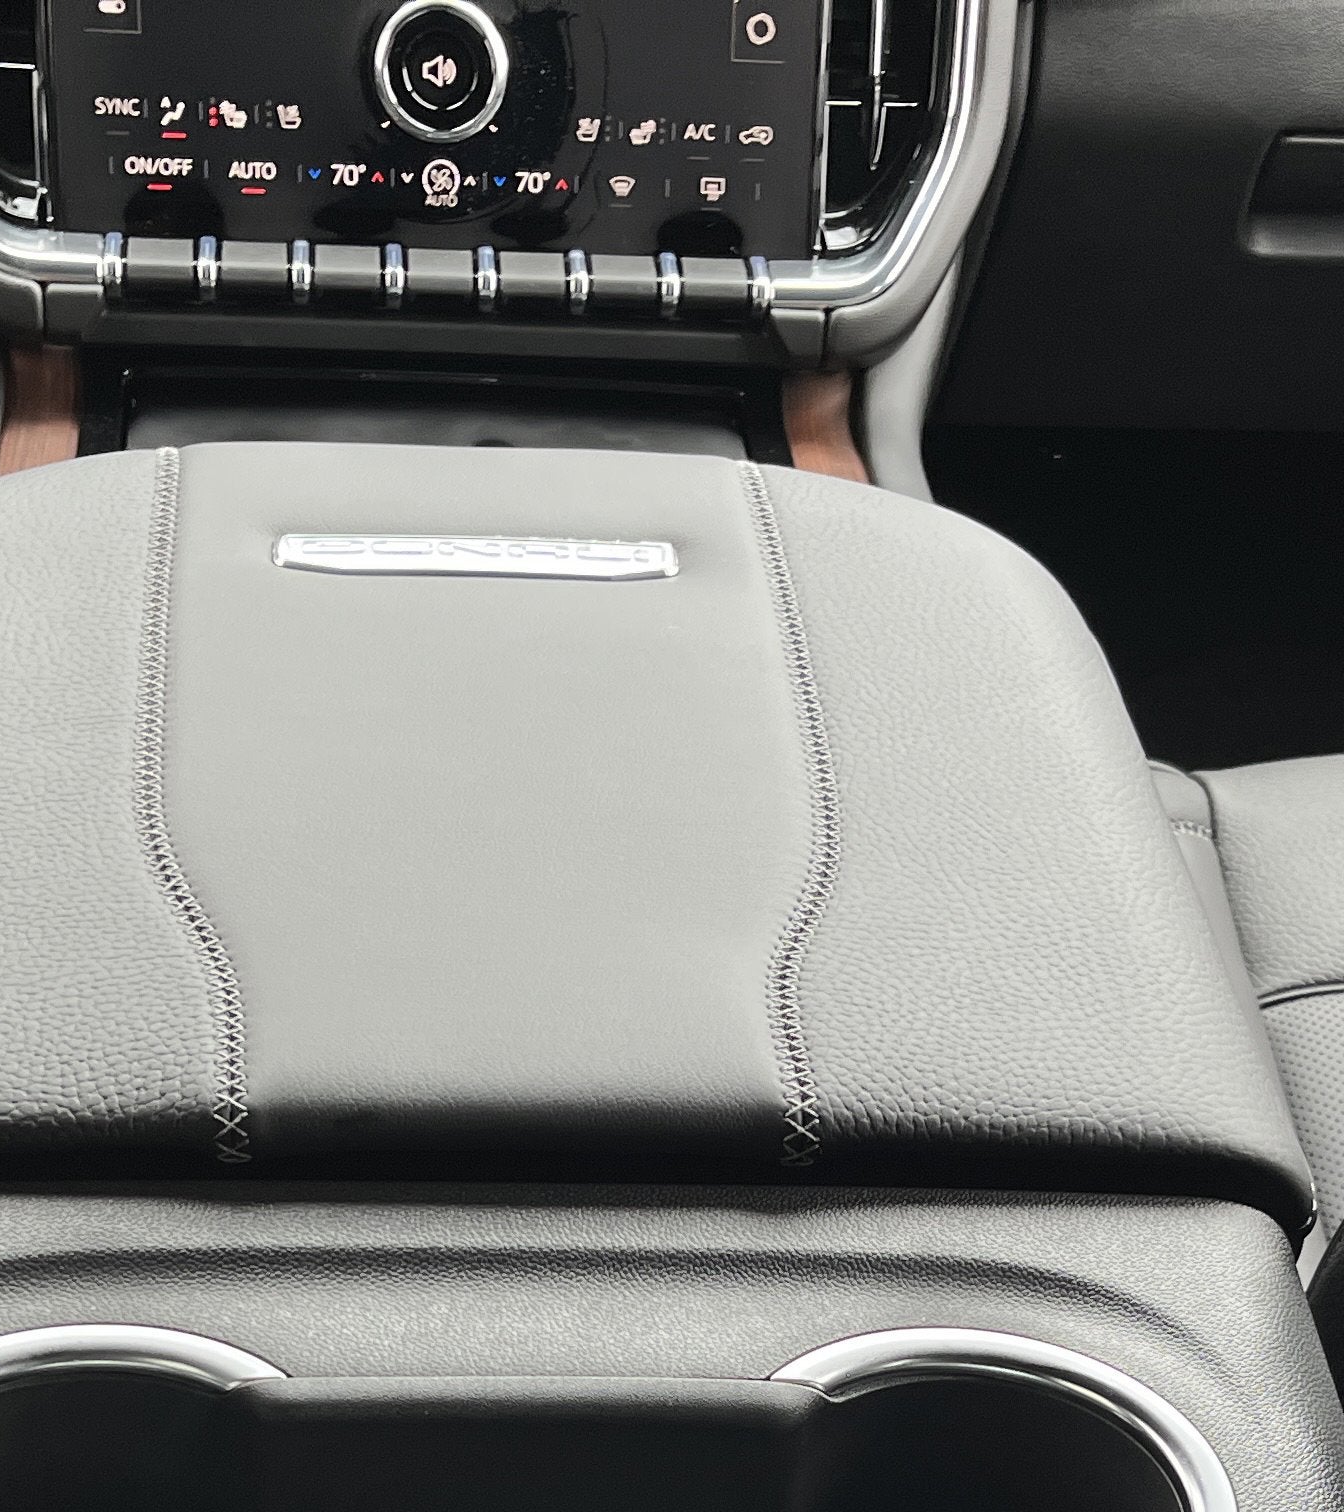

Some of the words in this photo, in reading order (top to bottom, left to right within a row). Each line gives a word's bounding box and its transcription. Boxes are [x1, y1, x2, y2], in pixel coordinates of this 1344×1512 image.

[94, 97, 141, 116] SYNC
[683, 123, 716, 141] A/C
[124, 156, 193, 177] ON/OFF
[228, 161, 277, 181] AUTO
[330, 164, 367, 187] 70°
[515, 171, 552, 194] 70°
[424, 195, 458, 207] AUTO
